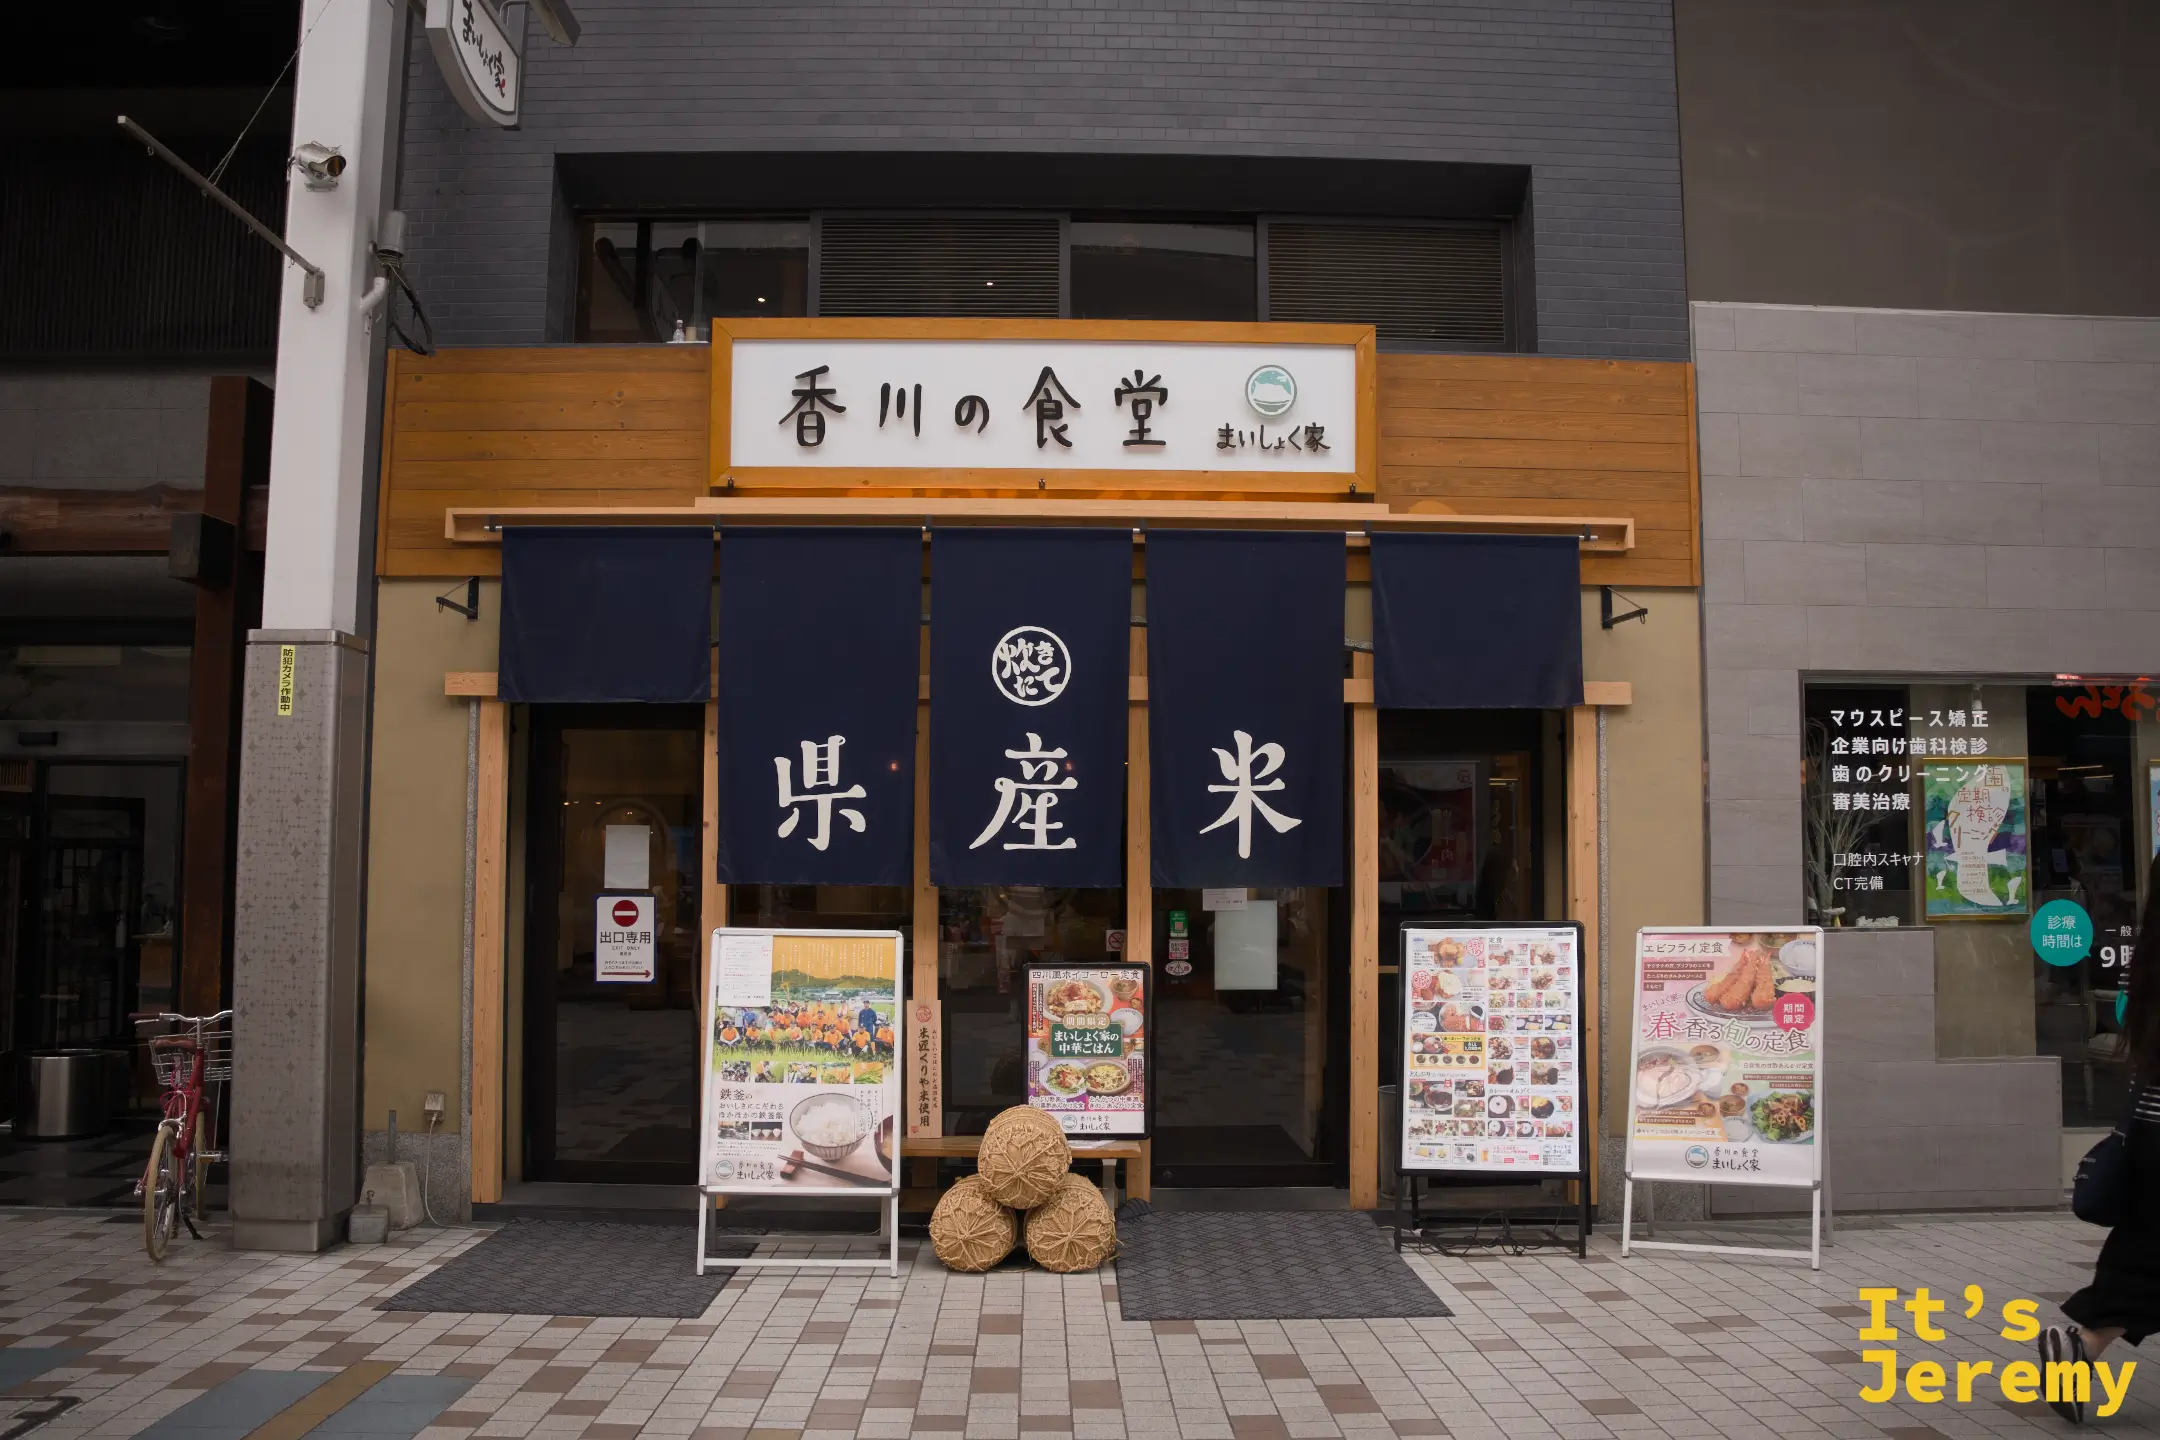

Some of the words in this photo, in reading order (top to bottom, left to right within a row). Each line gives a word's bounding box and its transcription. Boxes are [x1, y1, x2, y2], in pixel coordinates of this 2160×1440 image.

[779, 365, 1168, 448] 香川の食堂
[1216, 422, 1331, 453] まいしょく家
[280, 649, 293, 711] 防犯カメラ作動中
[1830, 708, 1989, 728] マウスピース矯正
[1831, 737, 1988, 755] 企業向け歯科検診
[1832, 764, 1988, 783] 歯のクリーニング
[1832, 792, 1910, 811] 審美治療
[1958, 786, 1990, 804] 定期
[1967, 804, 2005, 824] 検診
[1833, 853, 1924, 867] 口腔内スキャナ
[1833, 876, 1884, 890] CT完備
[2047, 915, 2076, 930] 診療
[600, 931, 651, 944] 出口専用
[2105, 925, 2141, 937] 一般
[2042, 934, 2083, 948] 時間は
[1644, 942, 1723, 954] エビフライ定食
[1032, 970, 1140, 980] 四川風ホイコーロー定食
[1783, 1003, 1805, 1013] 期間
[1065, 1016, 1107, 1026] 期間限定
[1783, 1014, 1805, 1025] 限定
[1054, 1031, 1119, 1042] まいしょく家の
[1645, 1012, 1810, 1052] 春香る旬の定食
[1059, 1042, 1114, 1054] 中華ごはん
[918, 1027, 930, 1127] 米匠くりや米使用
[719, 1088, 753, 1101] 鉄釜の
[719, 1102, 784, 1110] おいしさにこだわる
[718, 1111, 784, 1119] ほかほかの鉄釜飯
[1080, 1122, 1111, 1131] まいしょく家
[1713, 1147, 1759, 1158] 香川の食堂
[1712, 1159, 1761, 1171] まいしょく家
[736, 1170, 775, 1180] まいしょく家
